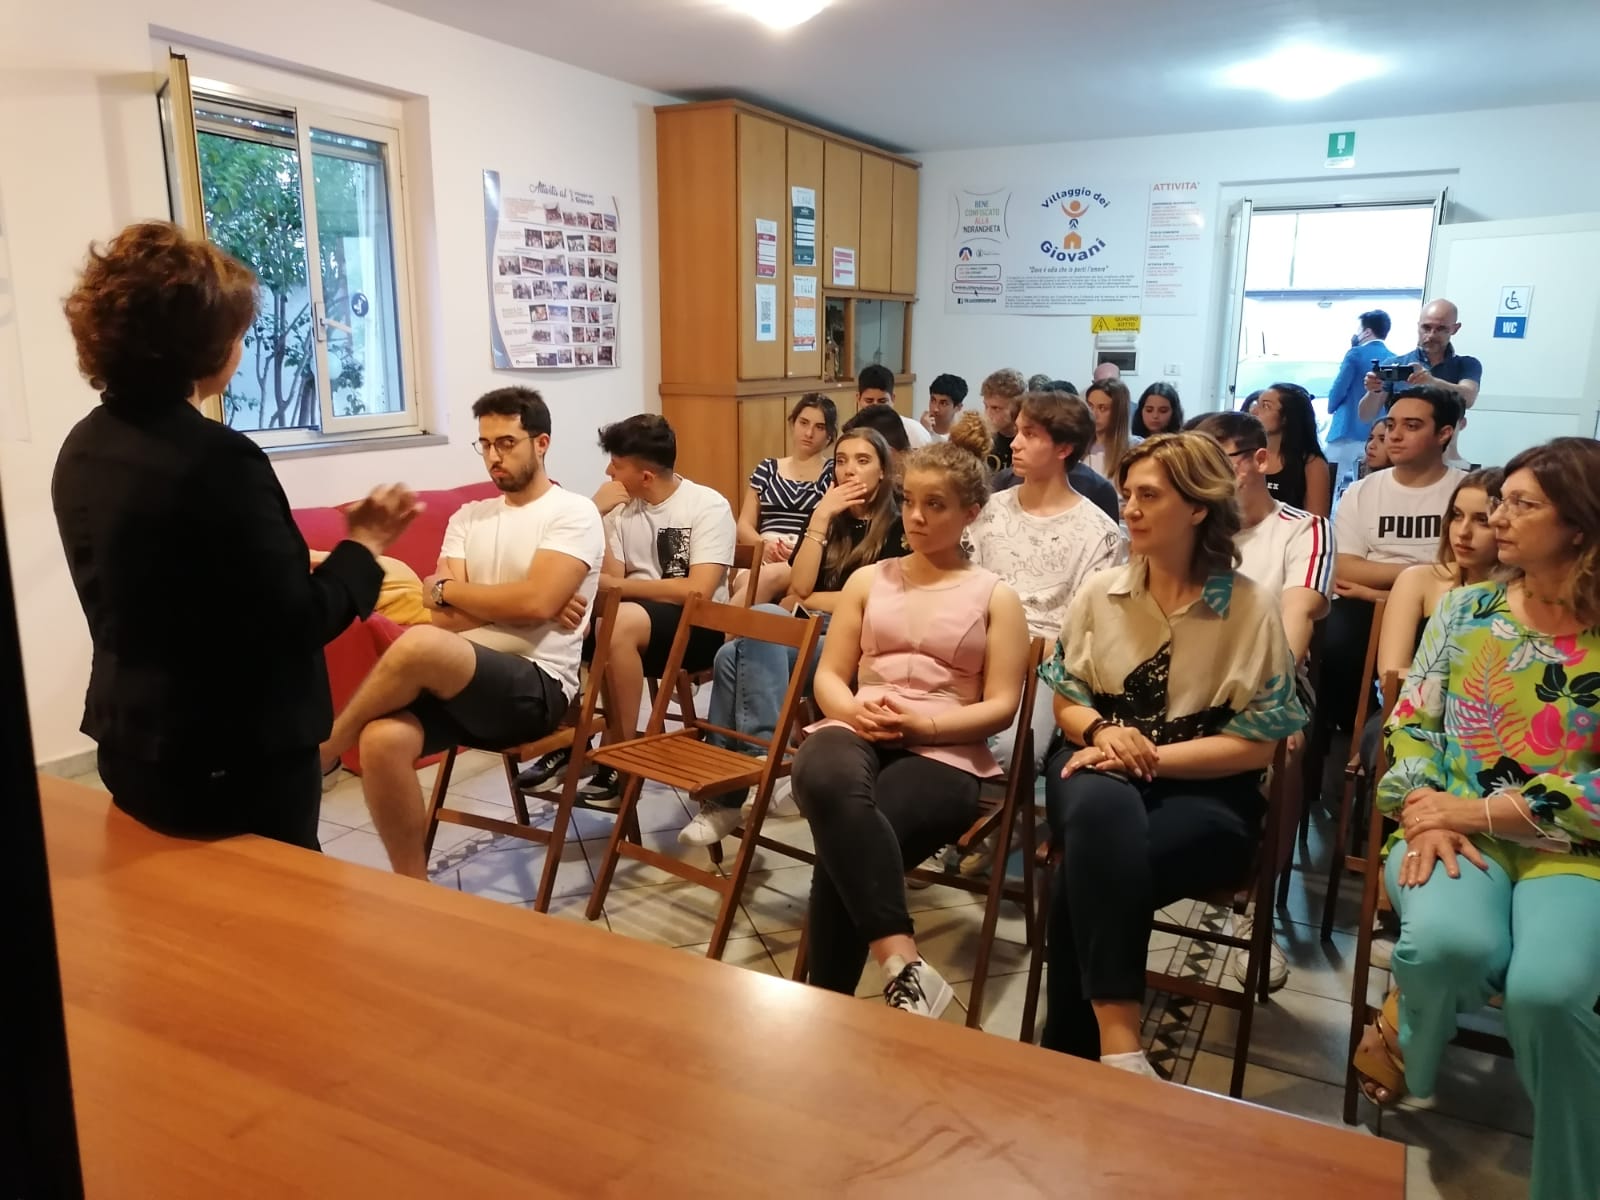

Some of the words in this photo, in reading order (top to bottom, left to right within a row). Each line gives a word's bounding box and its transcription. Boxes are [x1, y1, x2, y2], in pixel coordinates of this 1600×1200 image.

[975, 200, 989, 208] BENE
[1041, 187, 1091, 208] Villaggio
[1093, 192, 1111, 208] dei
[965, 208, 1000, 216] CONFISCATO
[1040, 237, 1106, 262] Giovani
[1502, 321, 1518, 334] WC
[1378, 515, 1441, 538] PUM
